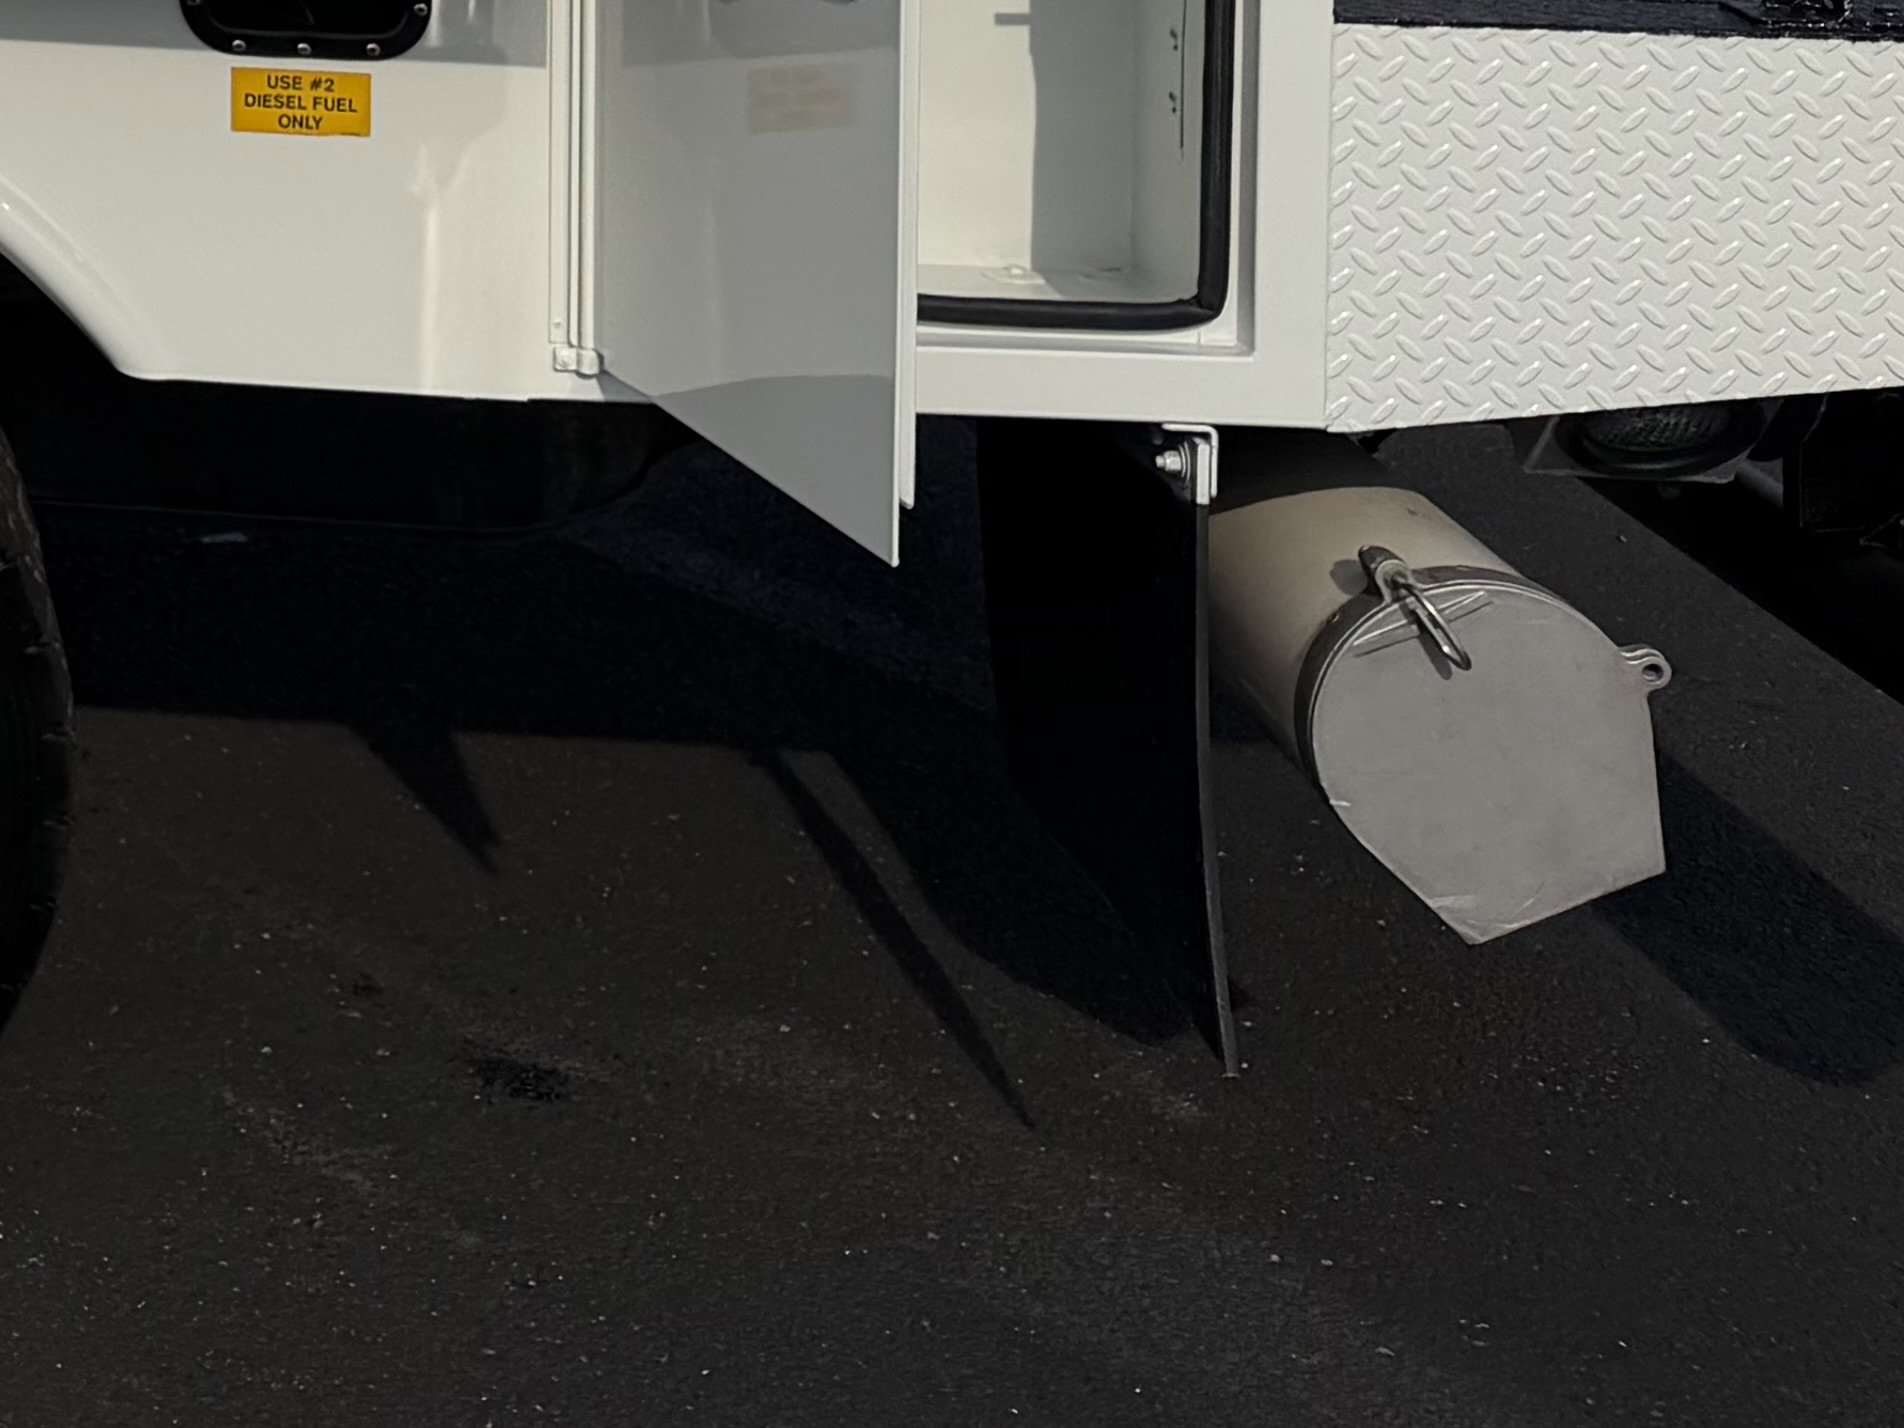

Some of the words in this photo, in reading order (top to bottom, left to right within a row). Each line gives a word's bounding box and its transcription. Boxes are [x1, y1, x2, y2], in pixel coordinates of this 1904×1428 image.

[266, 74, 303, 91] USE
[310, 77, 335, 93] #2
[244, 93, 307, 111] DIESEL
[313, 95, 358, 113] FUEL
[278, 113, 323, 131] ONLY
